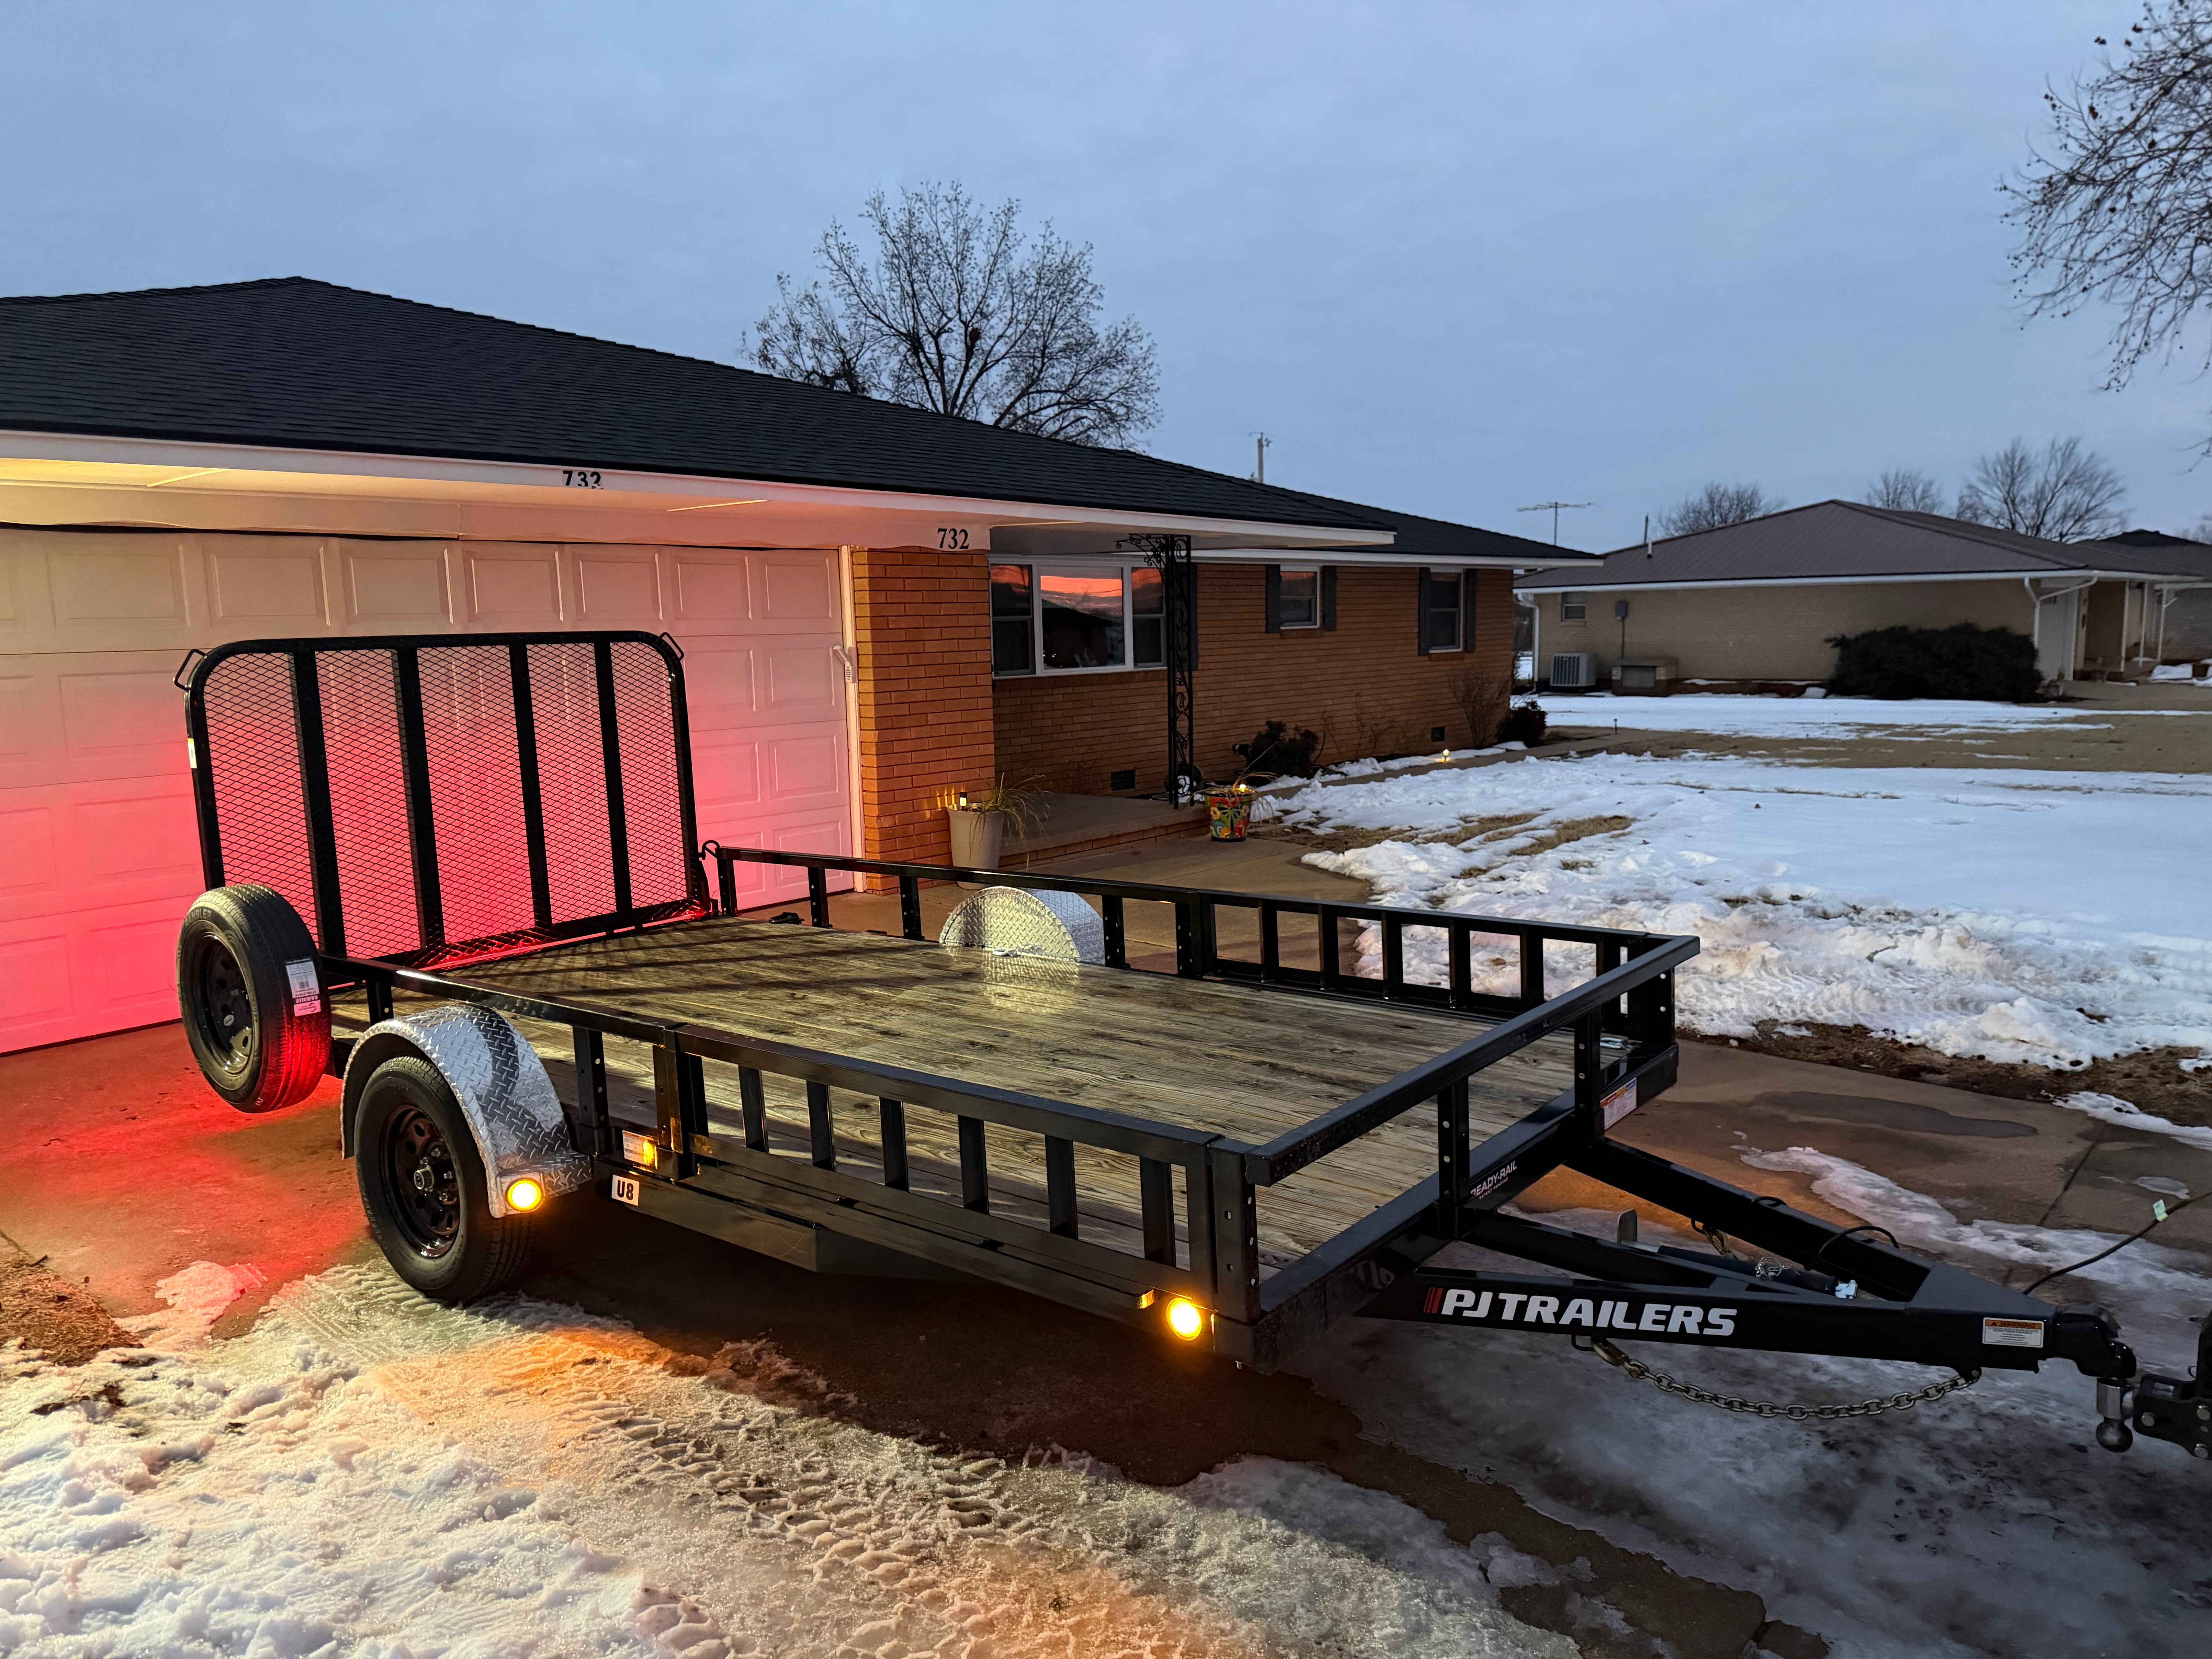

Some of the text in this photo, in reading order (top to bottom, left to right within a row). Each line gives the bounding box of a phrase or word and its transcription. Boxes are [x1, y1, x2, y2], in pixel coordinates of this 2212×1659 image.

[563, 470, 604, 489] 732
[937, 528, 969, 549] 732
[617, 1180, 634, 1200] U8
[1441, 1289, 1738, 1336] PJ TRAILERS
[2001, 1321, 2035, 1329] WARNING
